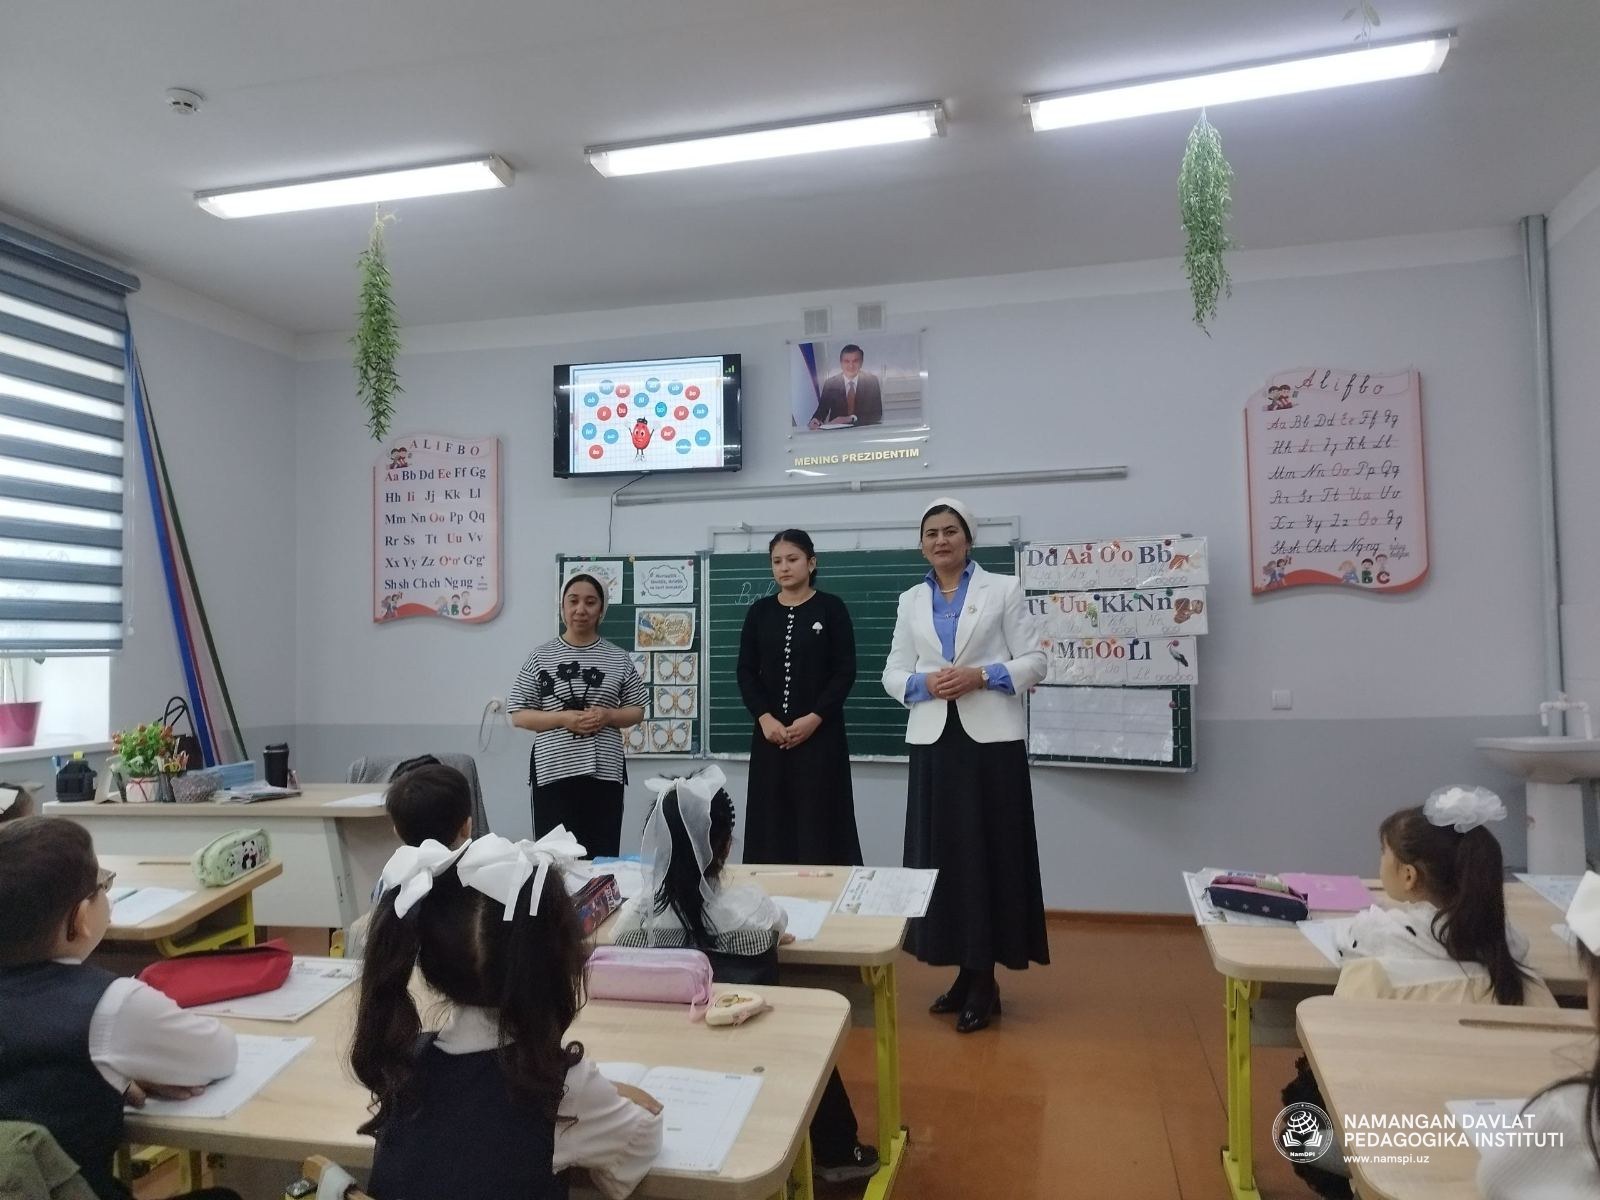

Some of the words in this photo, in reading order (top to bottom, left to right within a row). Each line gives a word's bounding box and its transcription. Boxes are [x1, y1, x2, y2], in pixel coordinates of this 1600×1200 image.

[795, 456, 839, 466] MENING
[842, 448, 919, 462] PREZIDENTIM
[384, 472, 399, 482] Aa
[402, 470, 416, 481] Bb
[420, 470, 434, 480] Dd
[438, 468, 451, 479] Ee
[455, 467, 468, 478] Ff
[470, 466, 486, 480] Gg
[385, 492, 401, 503] Hh
[407, 491, 415, 502] Ii
[424, 490, 435, 503] Jj
[445, 490, 461, 500] Kk
[470, 488, 481, 499] Ll
[385, 514, 406, 524] Mm
[411, 512, 426, 523] Nn
[430, 512, 445, 523] Oo
[450, 512, 464, 525] Pp
[469, 510, 485, 523] Qq
[385, 536, 399, 546] Rr
[404, 535, 415, 546] Ss
[425, 534, 438, 544] Tt
[448, 534, 462, 544] Uu
[468, 532, 483, 543] Vv
[384, 558, 400, 569] Xx
[403, 557, 418, 570] Yy
[421, 556, 435, 567] Zz
[1027, 548, 1058, 566] Dd
[1062, 548, 1093, 565] Aa
[1138, 544, 1172, 564] Bb
[1059, 596, 1088, 613] Uu
[1101, 594, 1134, 613] Kk
[1137, 594, 1173, 612] Nn
[1056, 642, 1094, 659] Mm
[1096, 641, 1125, 659] Oo
[1129, 642, 1152, 660] Ll
